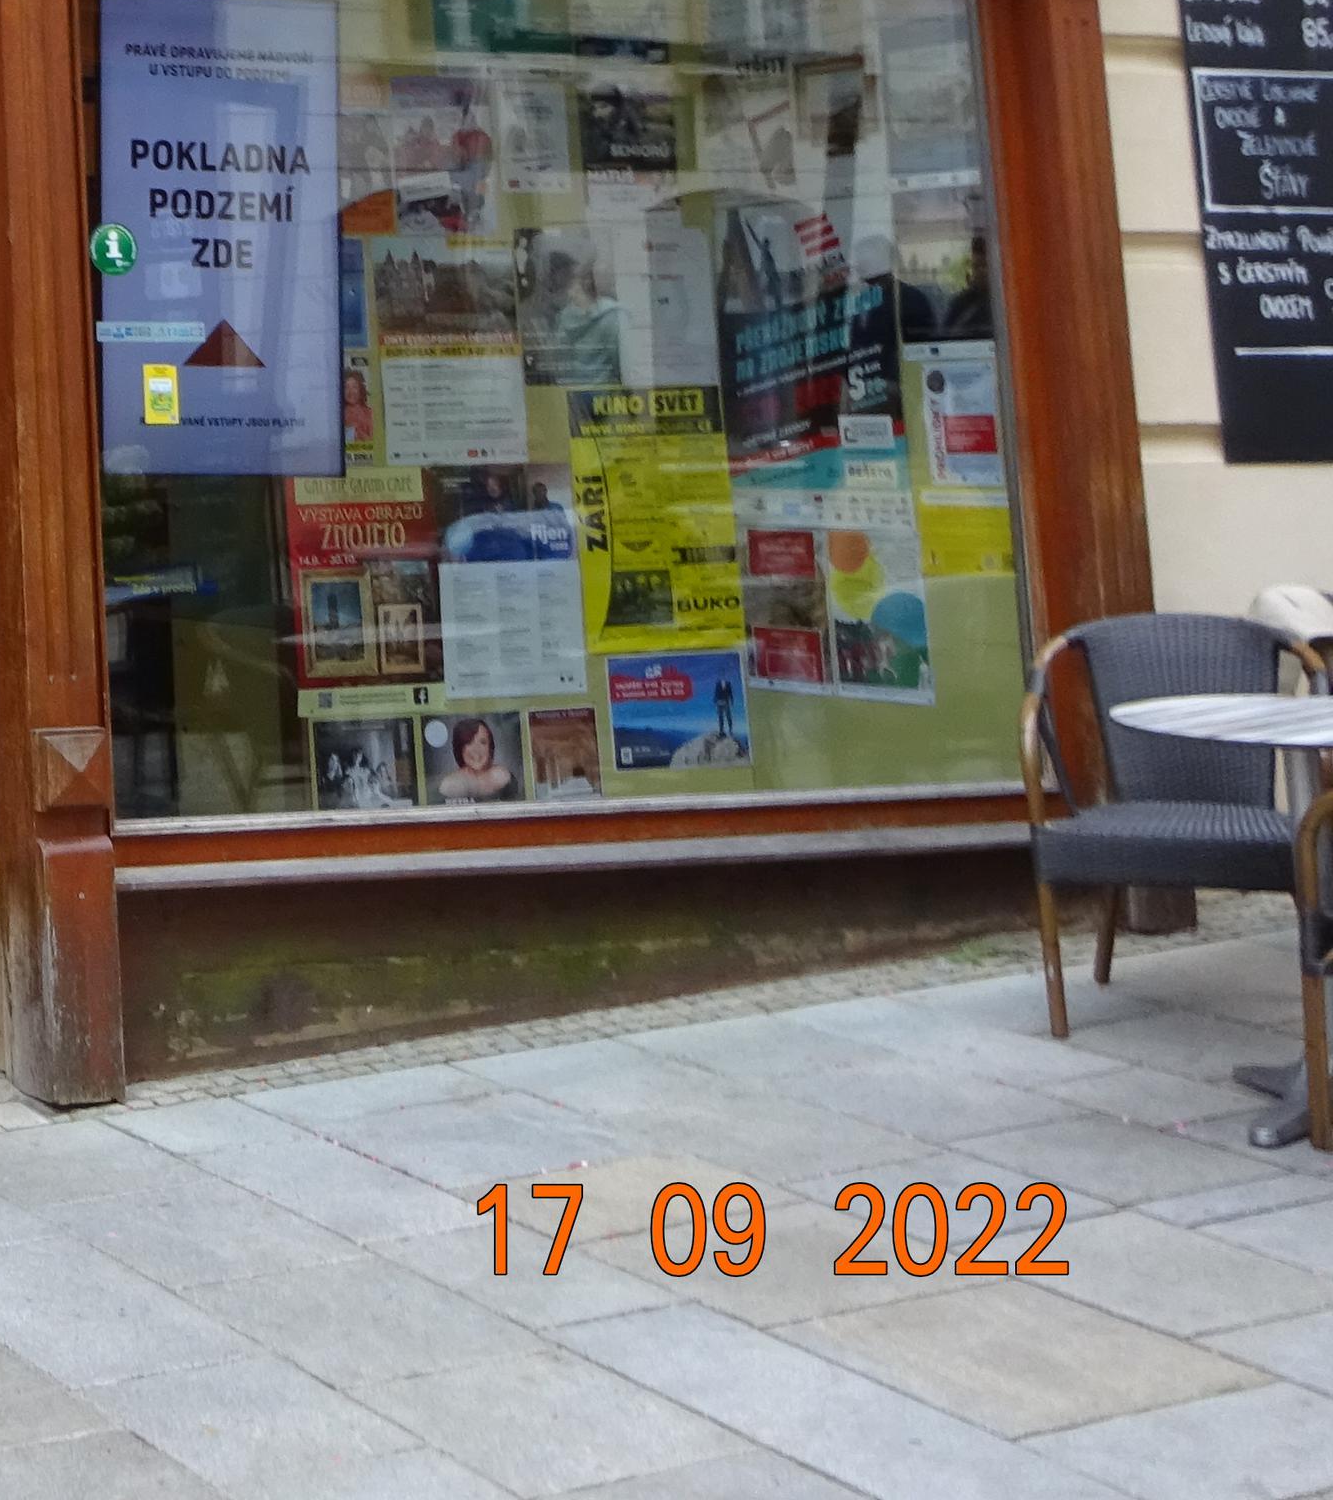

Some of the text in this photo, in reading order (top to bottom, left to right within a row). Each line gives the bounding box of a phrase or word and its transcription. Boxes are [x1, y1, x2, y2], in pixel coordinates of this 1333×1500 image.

[162, 64, 213, 78] VSTUPU
[130, 139, 311, 175] POKLADNA
[148, 185, 295, 223] PODZEMÍ
[191, 238, 253, 268] ZDE
